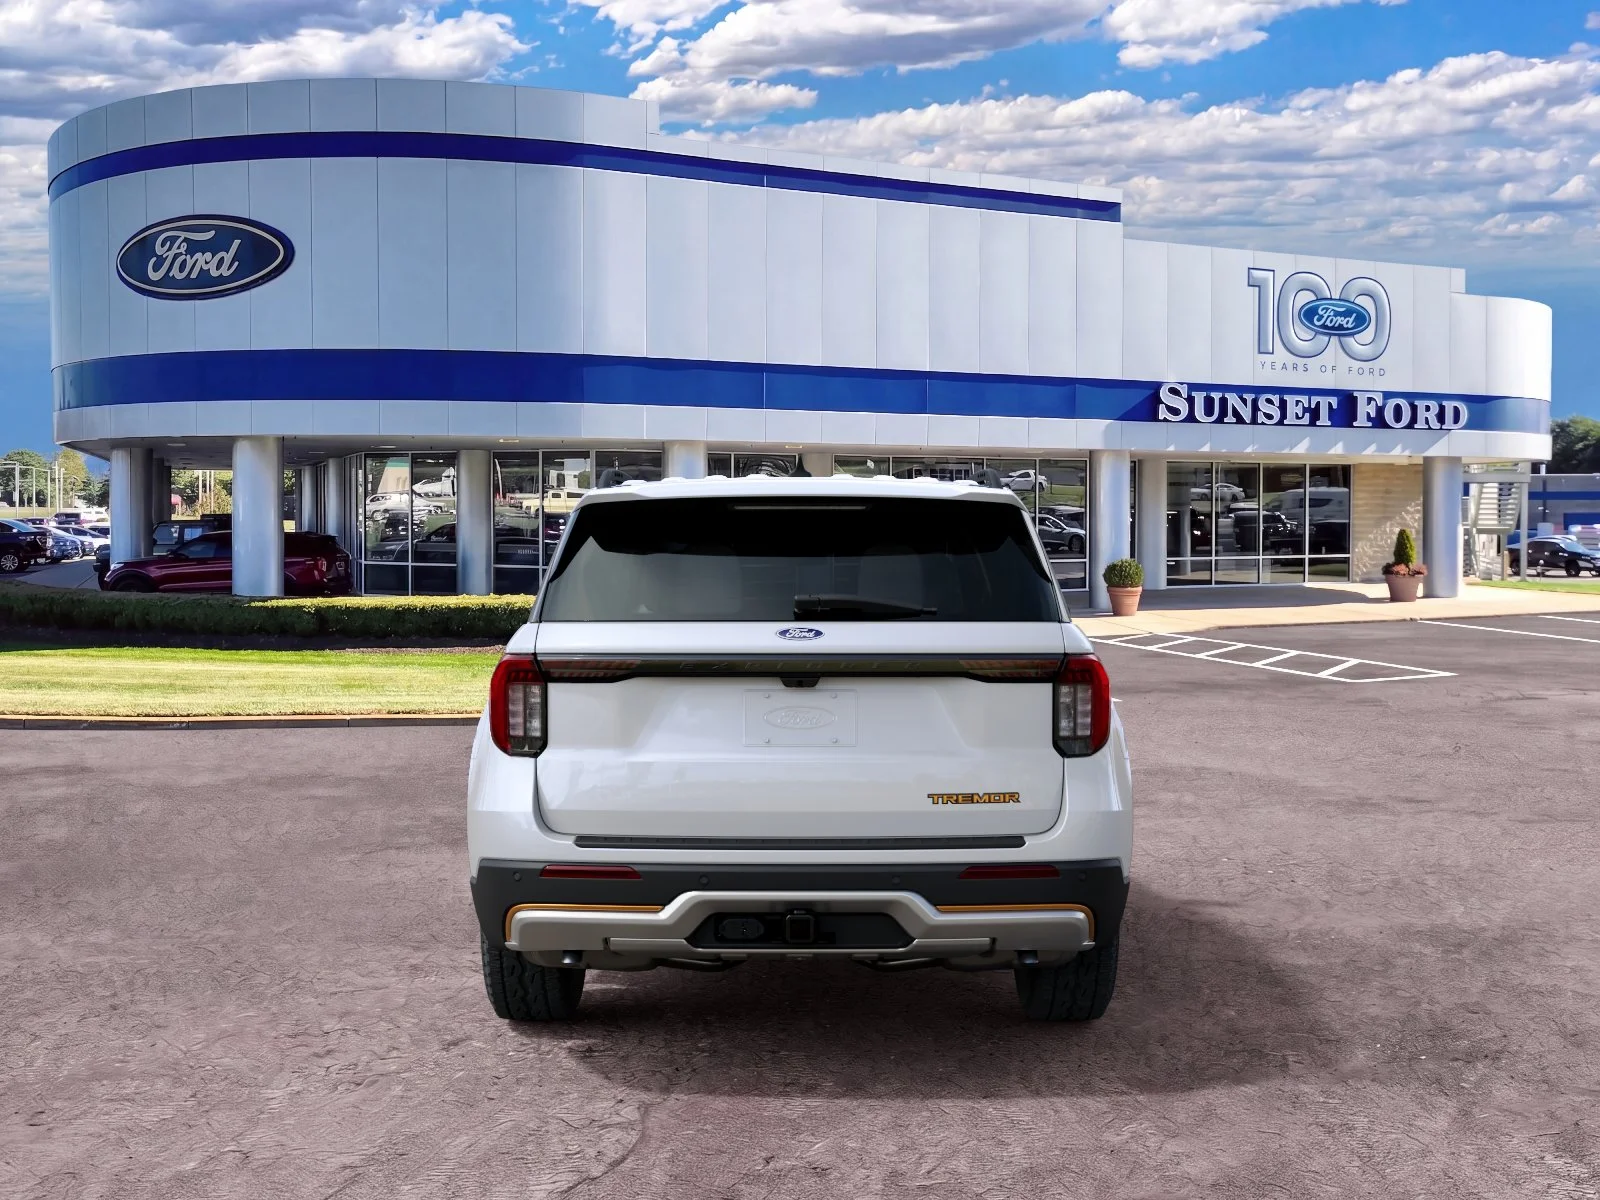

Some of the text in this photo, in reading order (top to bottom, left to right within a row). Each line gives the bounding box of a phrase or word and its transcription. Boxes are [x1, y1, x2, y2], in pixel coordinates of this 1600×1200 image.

[147, 230, 242, 281] Ford
[1247, 267, 1391, 362] 100
[1313, 305, 1357, 329] Ford
[1259, 361, 1386, 377] YEARS OF FORD
[1353, 391, 1468, 430] FORD
[786, 629, 816, 638] Ford
[927, 792, 1021, 805] TREMOR
